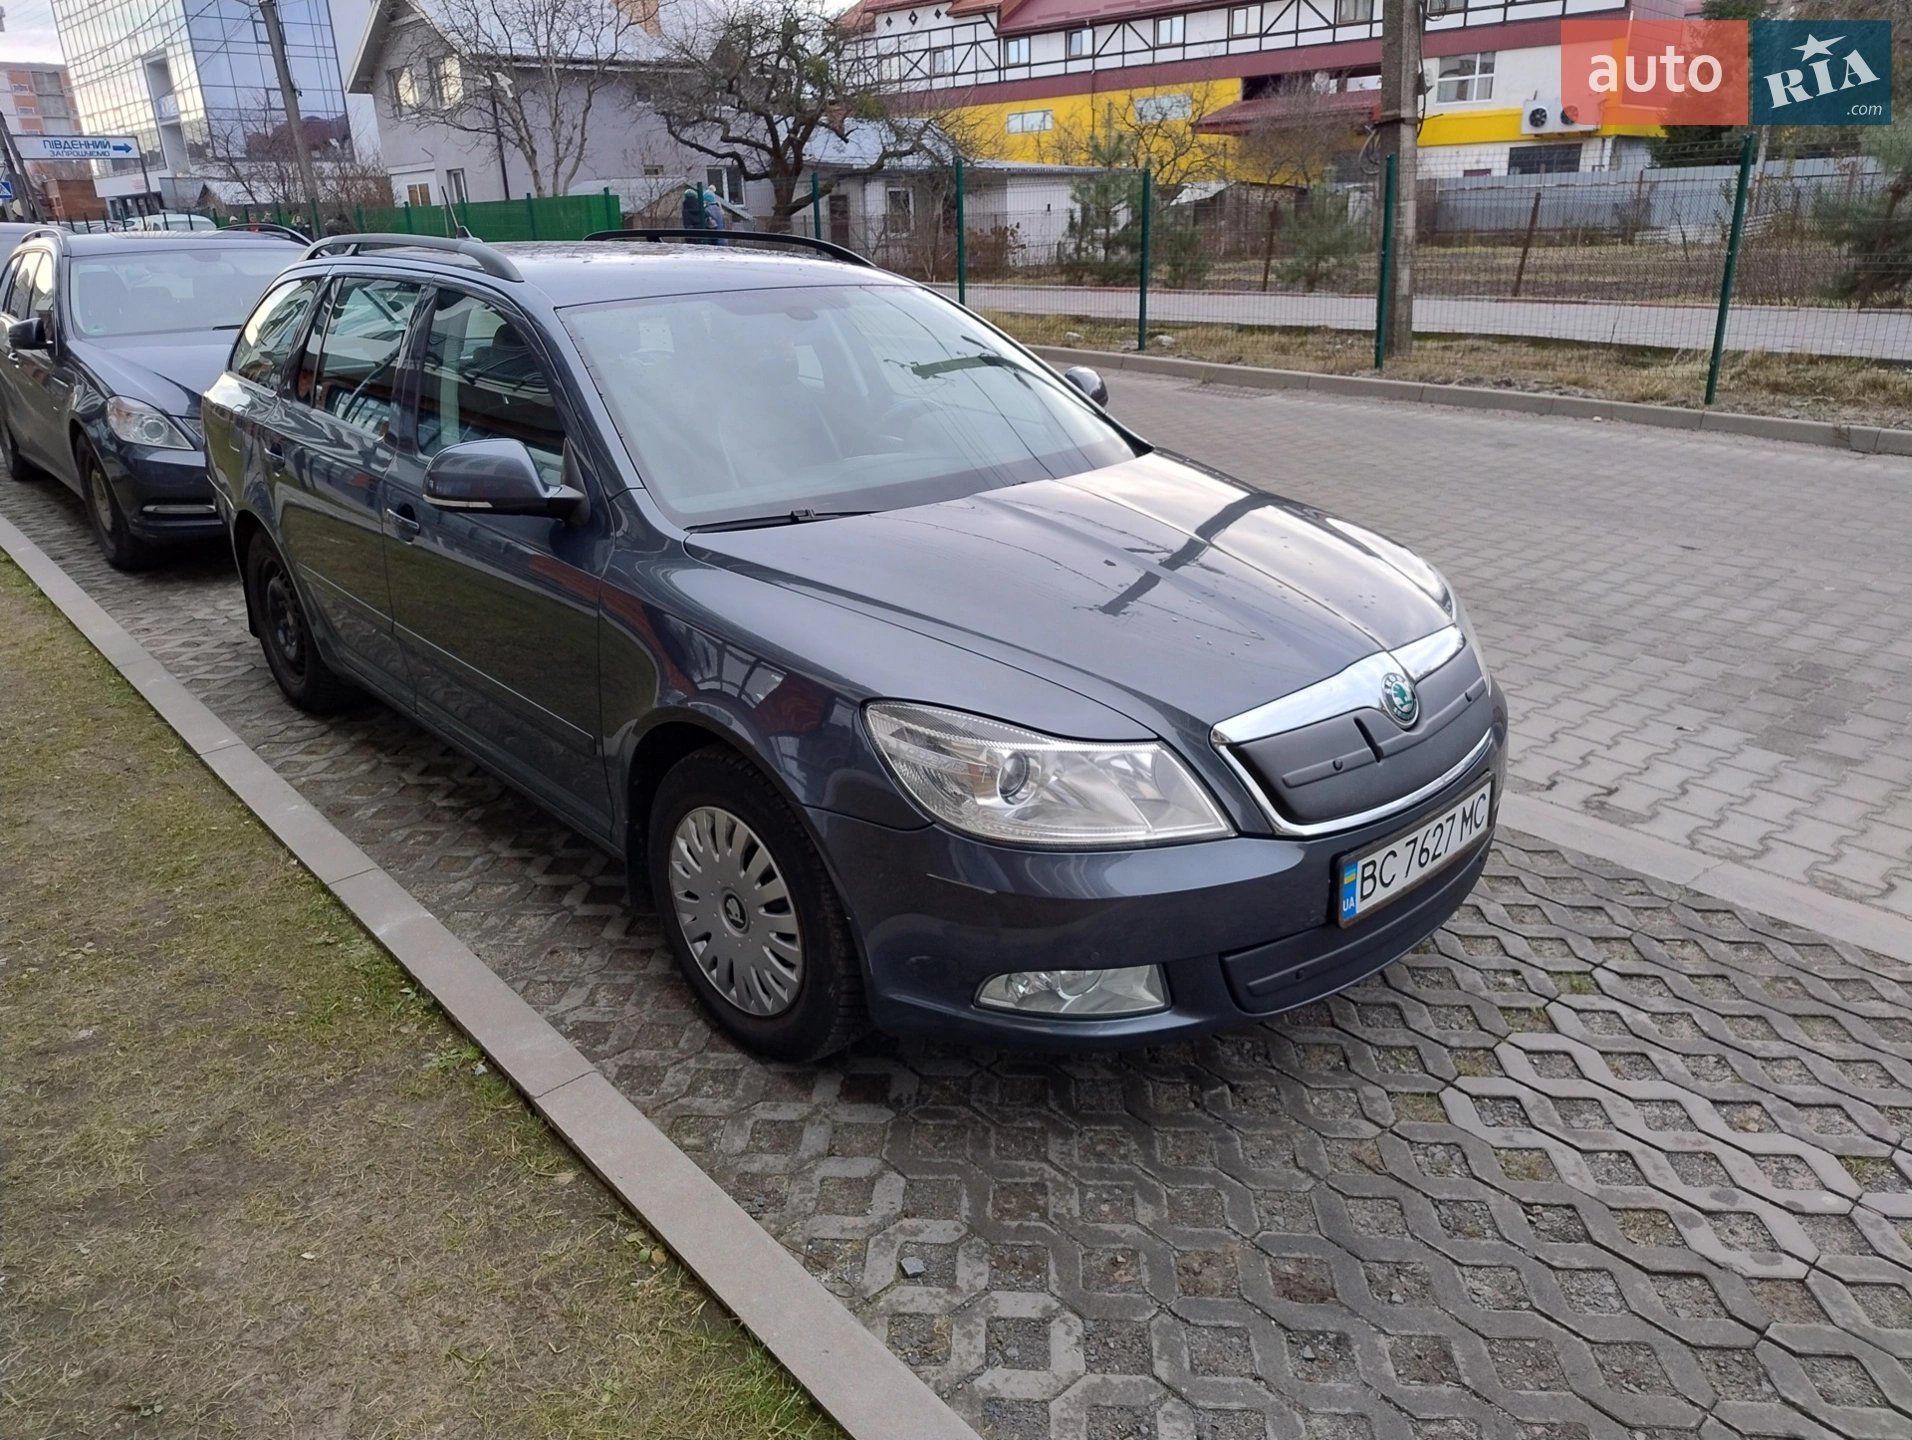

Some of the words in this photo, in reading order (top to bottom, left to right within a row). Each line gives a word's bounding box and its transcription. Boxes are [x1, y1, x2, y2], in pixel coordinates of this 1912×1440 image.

[1359, 849, 1398, 903] BC
[1404, 812, 1456, 878] 7627
[1460, 792, 1487, 842] MC
[1342, 897, 1355, 912] UA
